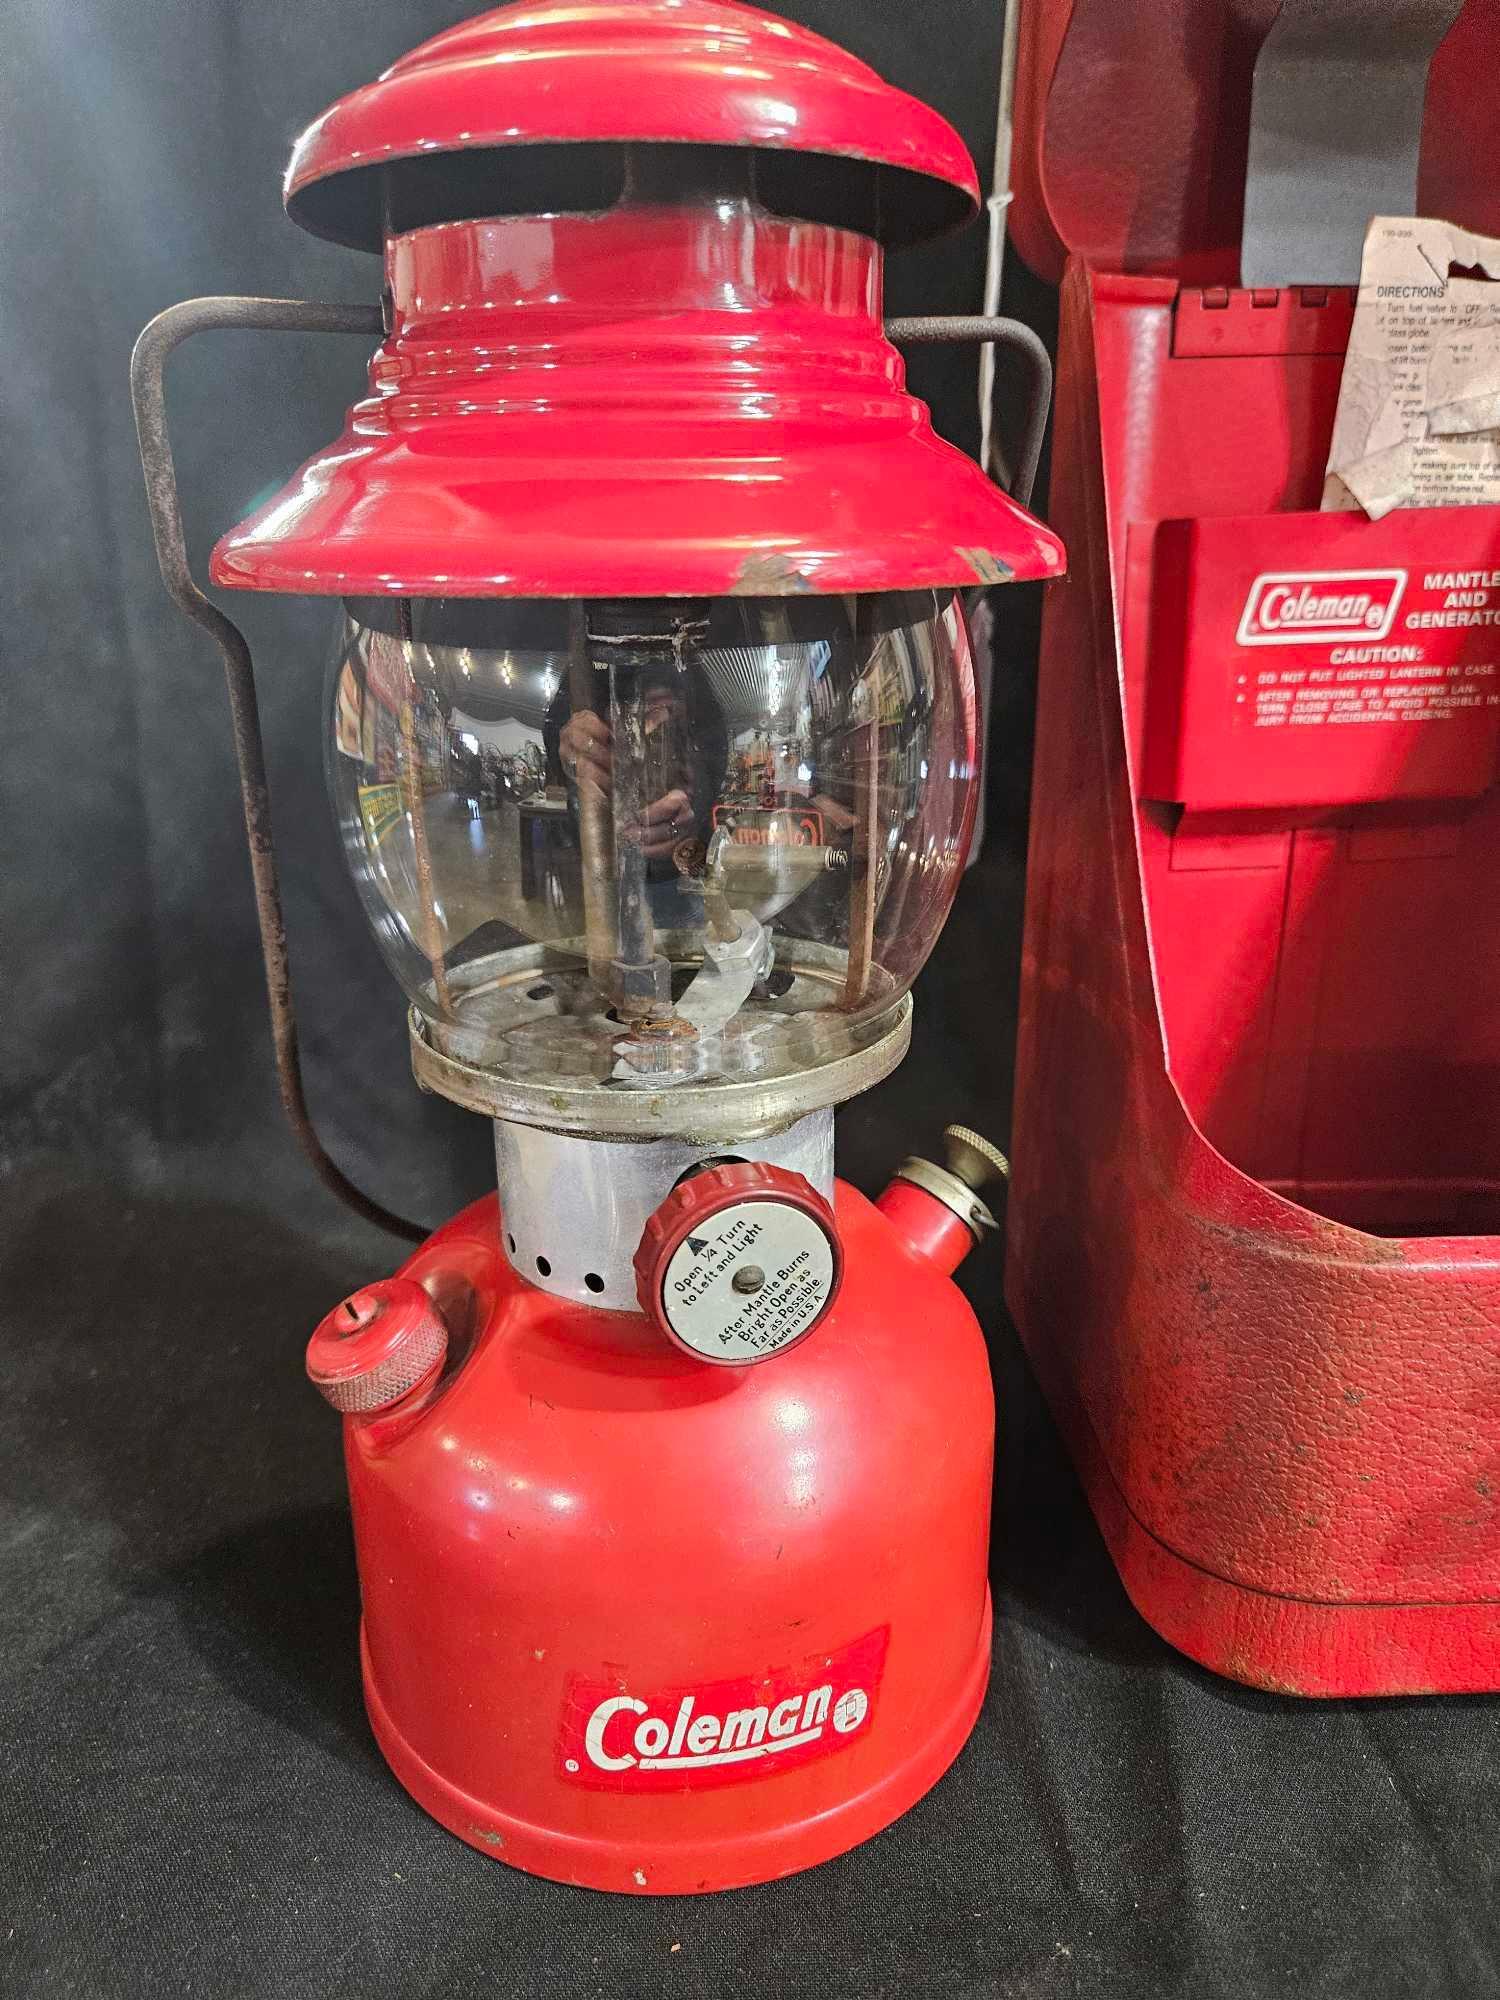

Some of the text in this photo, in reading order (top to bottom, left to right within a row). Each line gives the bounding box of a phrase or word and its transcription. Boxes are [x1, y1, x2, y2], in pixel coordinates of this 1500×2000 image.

[1377, 285, 1445, 298] DIRECTIONS
[1423, 570, 1500, 590] MANTLE
[1443, 591, 1488, 608] AND
[1259, 585, 1371, 631] Coleman
[1258, 664, 1496, 684] DO NOT PUT LIGHTED LANTERN IN CASE
[1329, 645, 1425, 665] CAUTION:
[1256, 689, 1293, 702] AFTER
[1295, 687, 1358, 701] REMOVING
[1360, 687, 1379, 699] OR
[1382, 684, 1447, 698] REPLACING
[1292, 700, 1330, 713] CLOSE
[1368, 698, 1384, 710] TO
[1427, 694, 1482, 708] POSSIBLE
[674, 1265, 703, 1292] Open
[716, 1220, 745, 1246] Turn
[682, 1223, 763, 1307] to Left and Light
[717, 1250, 810, 1345] After Mantle Burns
[737, 1269, 812, 1342] Bright Open as
[750, 1277, 823, 1350] Far as Possible.
[768, 1294, 826, 1350] Made in U.S.A.
[585, 1684, 833, 1771] Coleman
